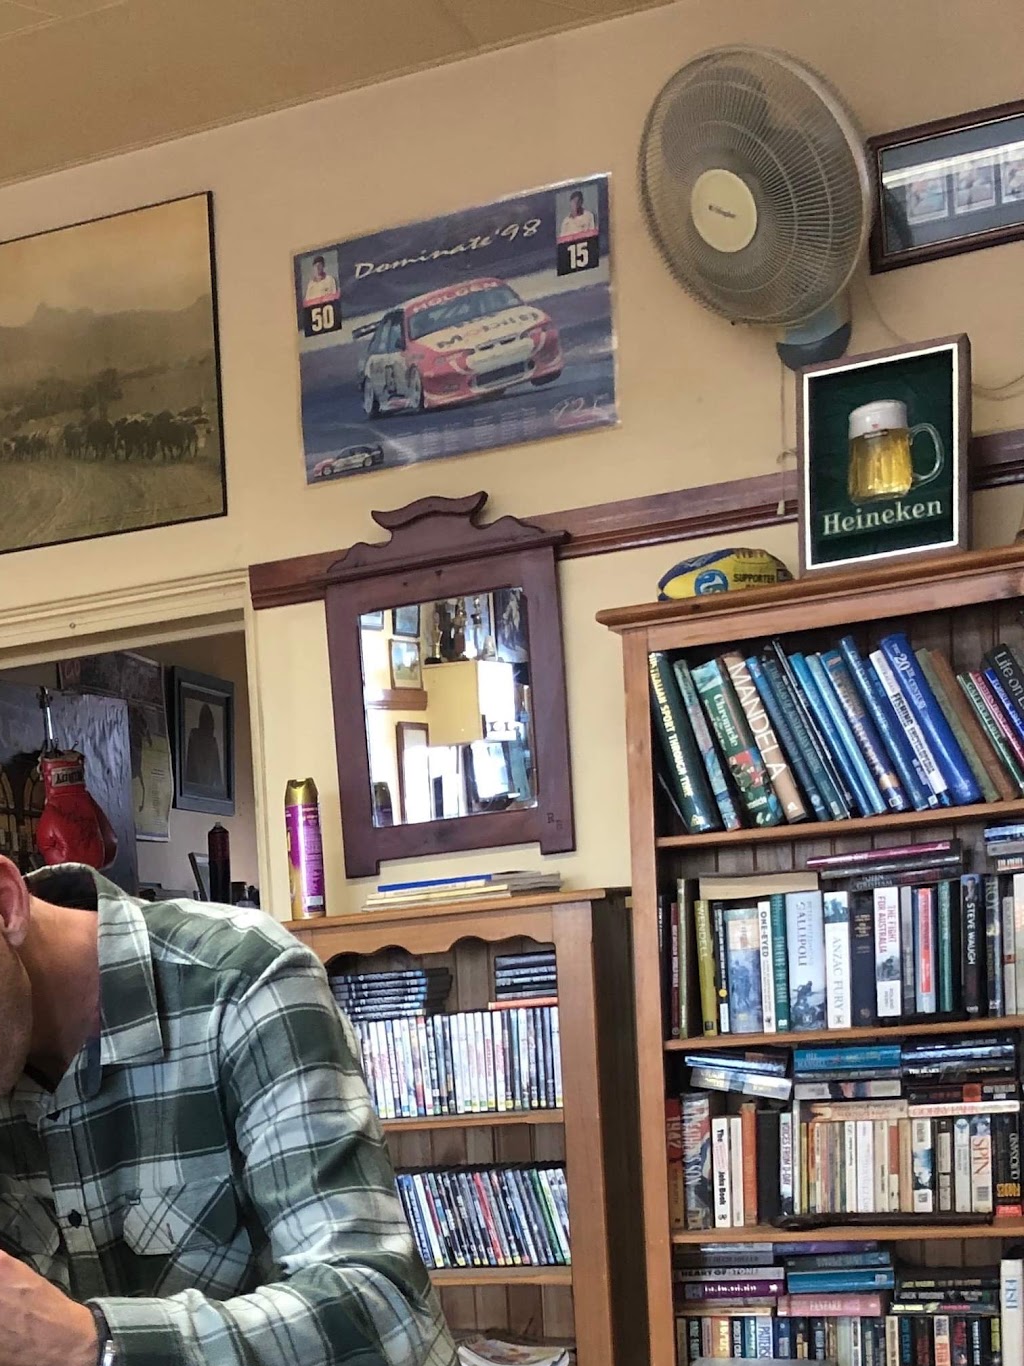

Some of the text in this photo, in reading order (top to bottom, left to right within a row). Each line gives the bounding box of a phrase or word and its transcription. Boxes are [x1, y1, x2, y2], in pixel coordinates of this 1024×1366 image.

[354, 236, 493, 280] Dominate
[567, 242, 589, 269] 15
[310, 306, 335, 332] 50
[822, 500, 943, 536] Heineken
[733, 573, 775, 584] SUPPORTER
[995, 651, 1024, 696] Life on
[714, 694, 739, 747] Chronicle
[728, 661, 787, 780] MANDELA
[889, 691, 915, 728] FISHING
[905, 726, 937, 775] ENCYCLOPEDIA
[660, 704, 675, 732] SPORT
[668, 731, 687, 776] THROUGH
[679, 775, 694, 798] TIME
[986, 881, 998, 912] ROY
[698, 907, 708, 961] WENDELL
[760, 911, 770, 958] ONE-EYED
[796, 901, 808, 967] GALLIPOLI
[877, 896, 887, 954] FOR AUSTRALIA
[887, 905, 897, 943] THE FIGHT
[967, 902, 977, 965] STEVE WAUGH
[776, 982, 787, 1003] SHARK
[832, 937, 844, 1010] ANZAC FURY
[667, 1116, 682, 1149] 1942
[782, 1122, 791, 1145] VOICES
[717, 1129, 727, 1206] The Joke Book
[782, 1146, 791, 1165] FROM
[973, 1137, 989, 1176] SPIN
[685, 1165, 702, 1185] SON
[681, 1268, 711, 1278] HEART
[714, 1268, 726, 1277] OF
[1005, 1279, 1018, 1310] FISH
[733, 1321, 741, 1358] ROBERT CRA
